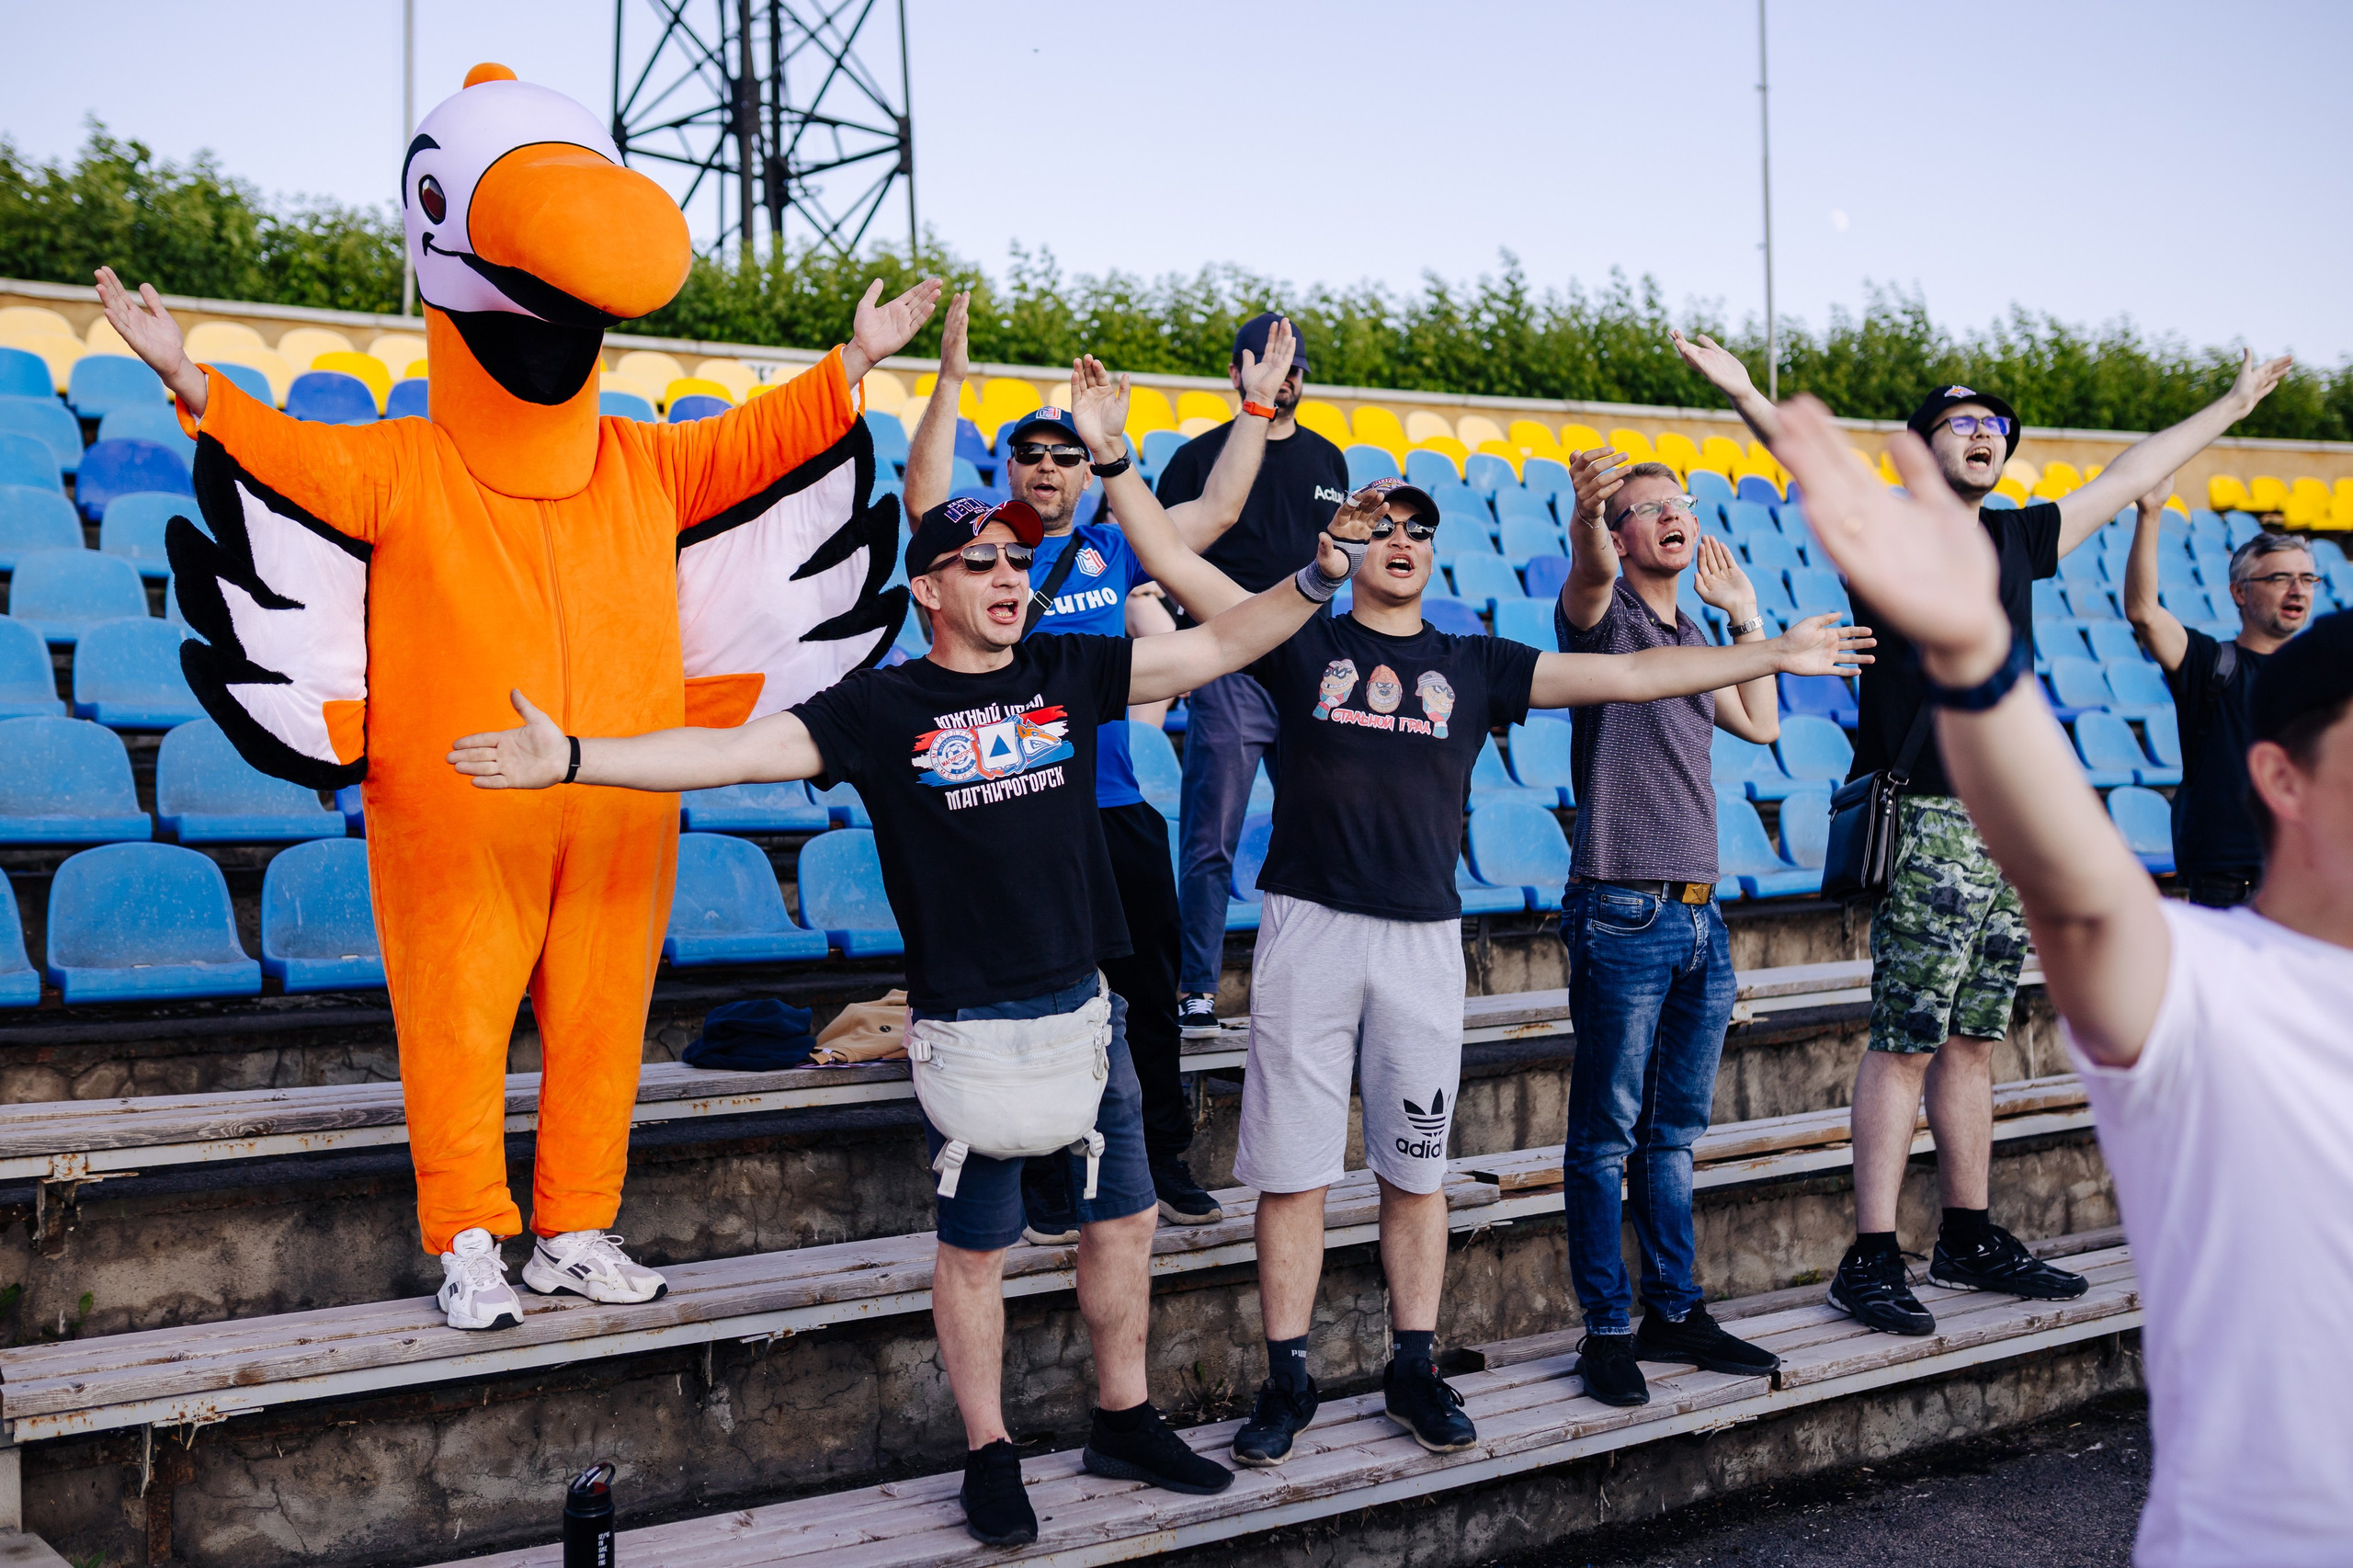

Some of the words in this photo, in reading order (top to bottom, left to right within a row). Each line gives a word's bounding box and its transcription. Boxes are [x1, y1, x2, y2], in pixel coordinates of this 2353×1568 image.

[934, 702, 1001, 729] ЮЖНЫЙ
[1331, 708, 1395, 732] СТАЛЬНОЙ
[1398, 717, 1431, 735] ГРАД
[932, 731, 974, 759] МЕТАЛЛУРГ
[941, 748, 973, 767] МАГНИТОГОРС
[945, 766, 1064, 811] МАГНИТОГОРСК
[1395, 1138, 1443, 1159] adid
[1291, 1349, 1307, 1358] PUM
